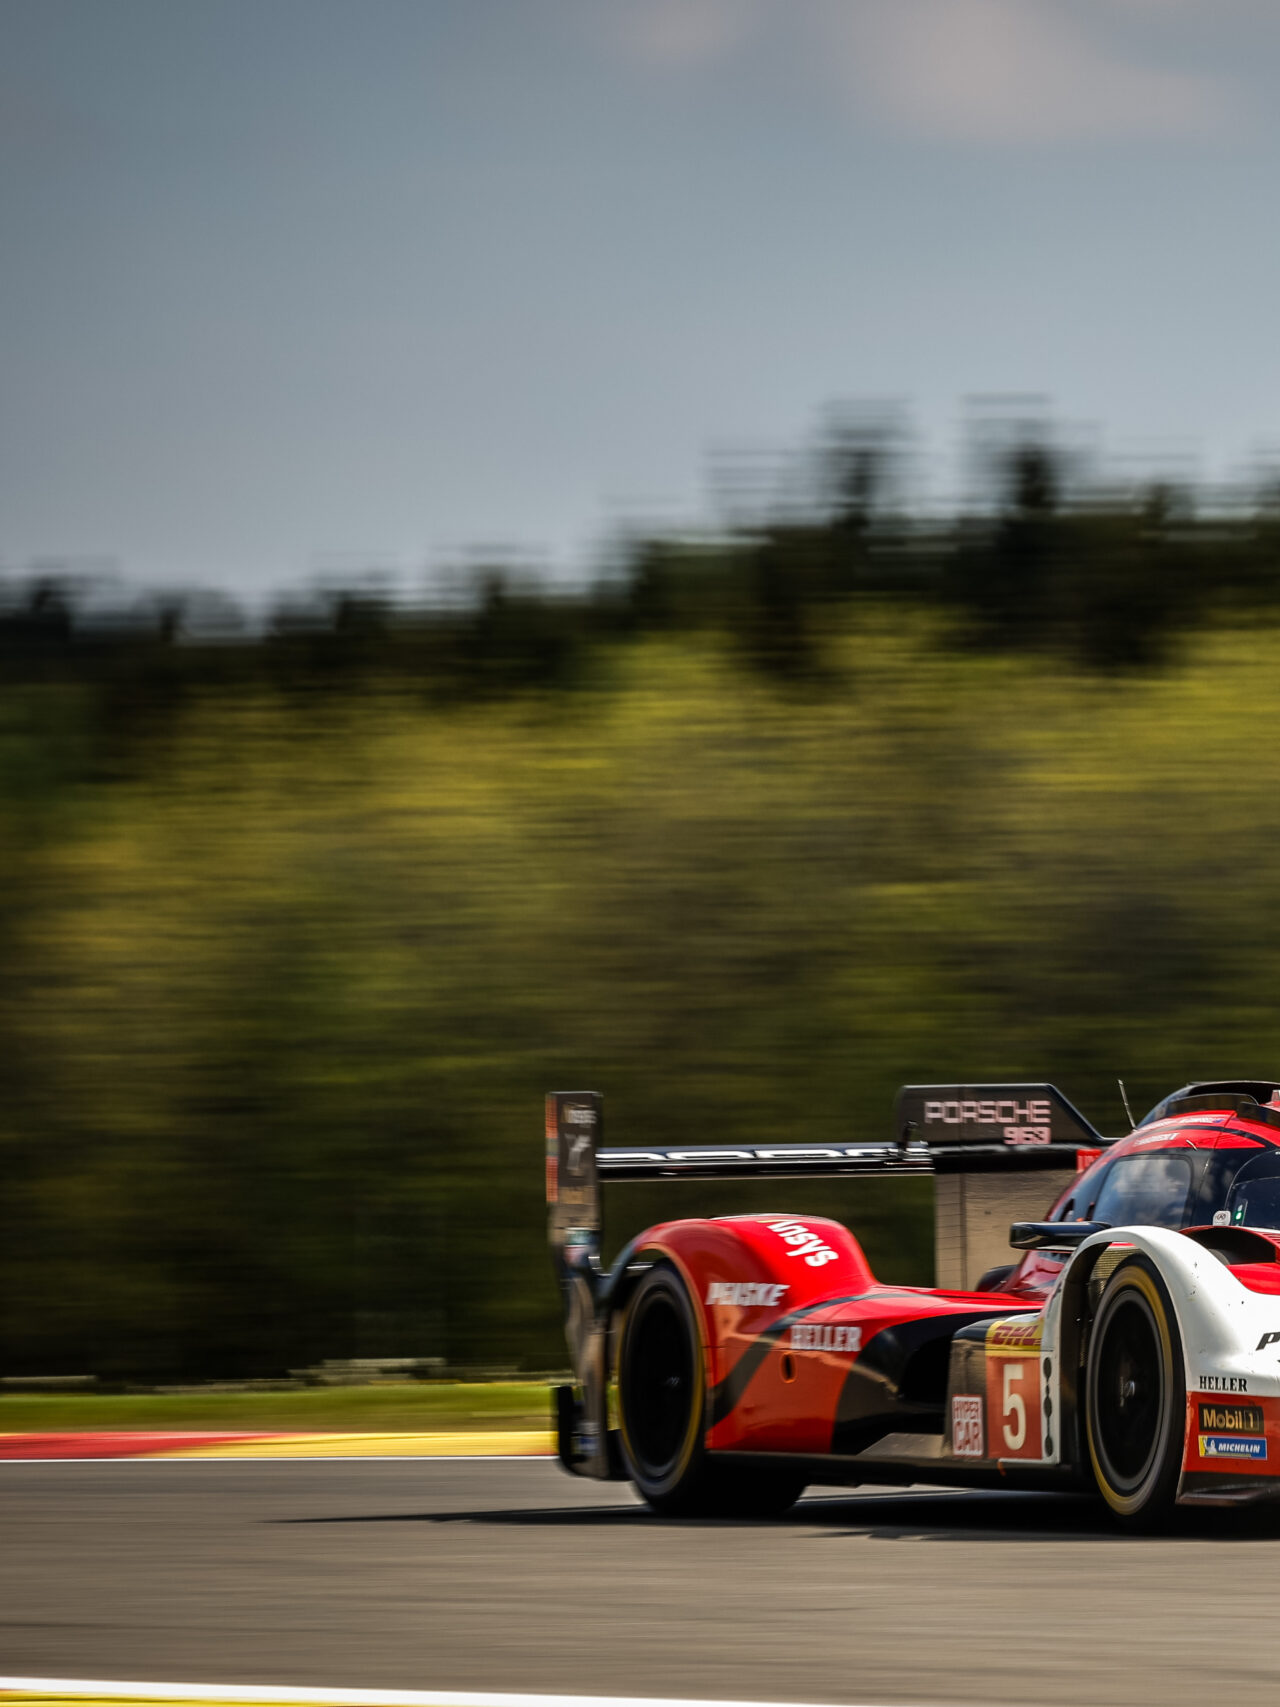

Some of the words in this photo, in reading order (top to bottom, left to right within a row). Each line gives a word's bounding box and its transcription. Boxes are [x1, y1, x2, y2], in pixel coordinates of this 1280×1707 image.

[924, 1101, 1051, 1124] PORSCHE
[790, 1324, 861, 1352] HELLER
[1199, 1375, 1248, 1392] HELLER
[1002, 1364, 1026, 1450] 5
[1203, 1408, 1242, 1430] Mobil
[1218, 1442, 1260, 1454] MICHELIN
